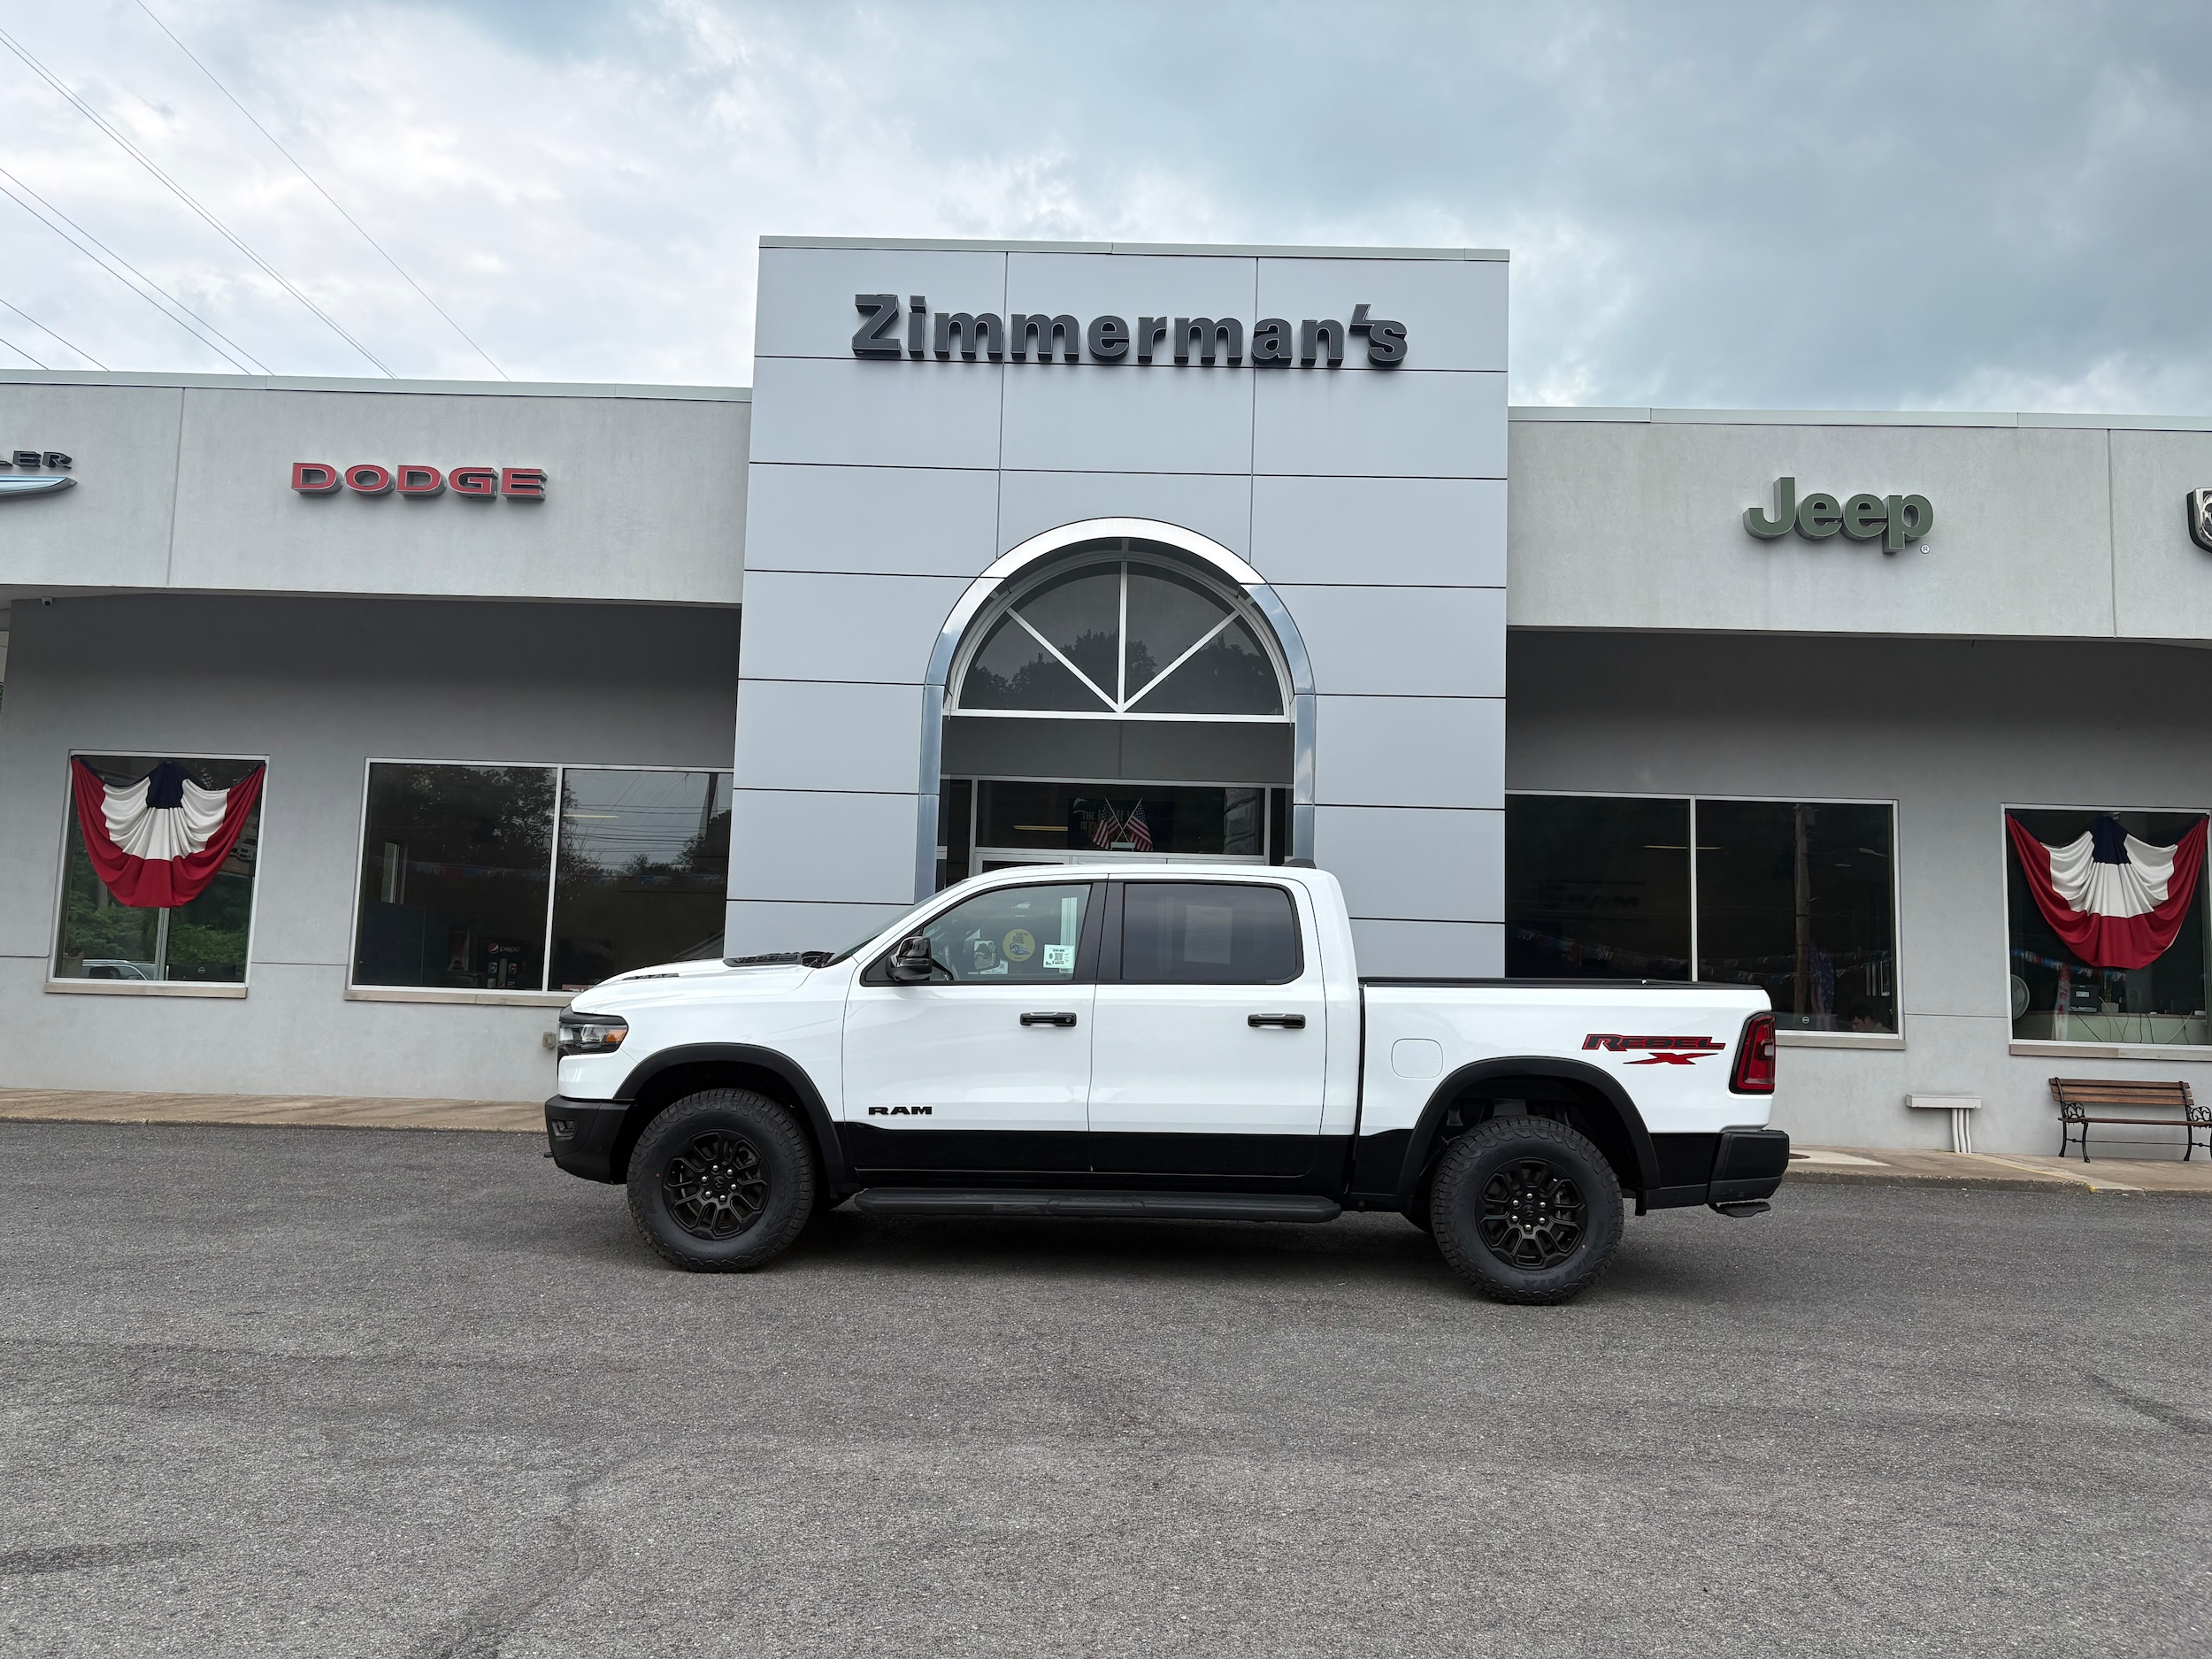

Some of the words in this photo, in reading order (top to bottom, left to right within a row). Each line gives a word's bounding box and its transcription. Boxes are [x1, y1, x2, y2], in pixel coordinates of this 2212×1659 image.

[851, 294, 1409, 366] Zimmerman's
[291, 462, 547, 501] DODGE
[1743, 477, 1934, 553] Jeep
[1082, 810, 1096, 821] THE
[1582, 1034, 1725, 1051] REBEL
[1623, 1052, 1719, 1065] X
[868, 1106, 933, 1115] RAM
